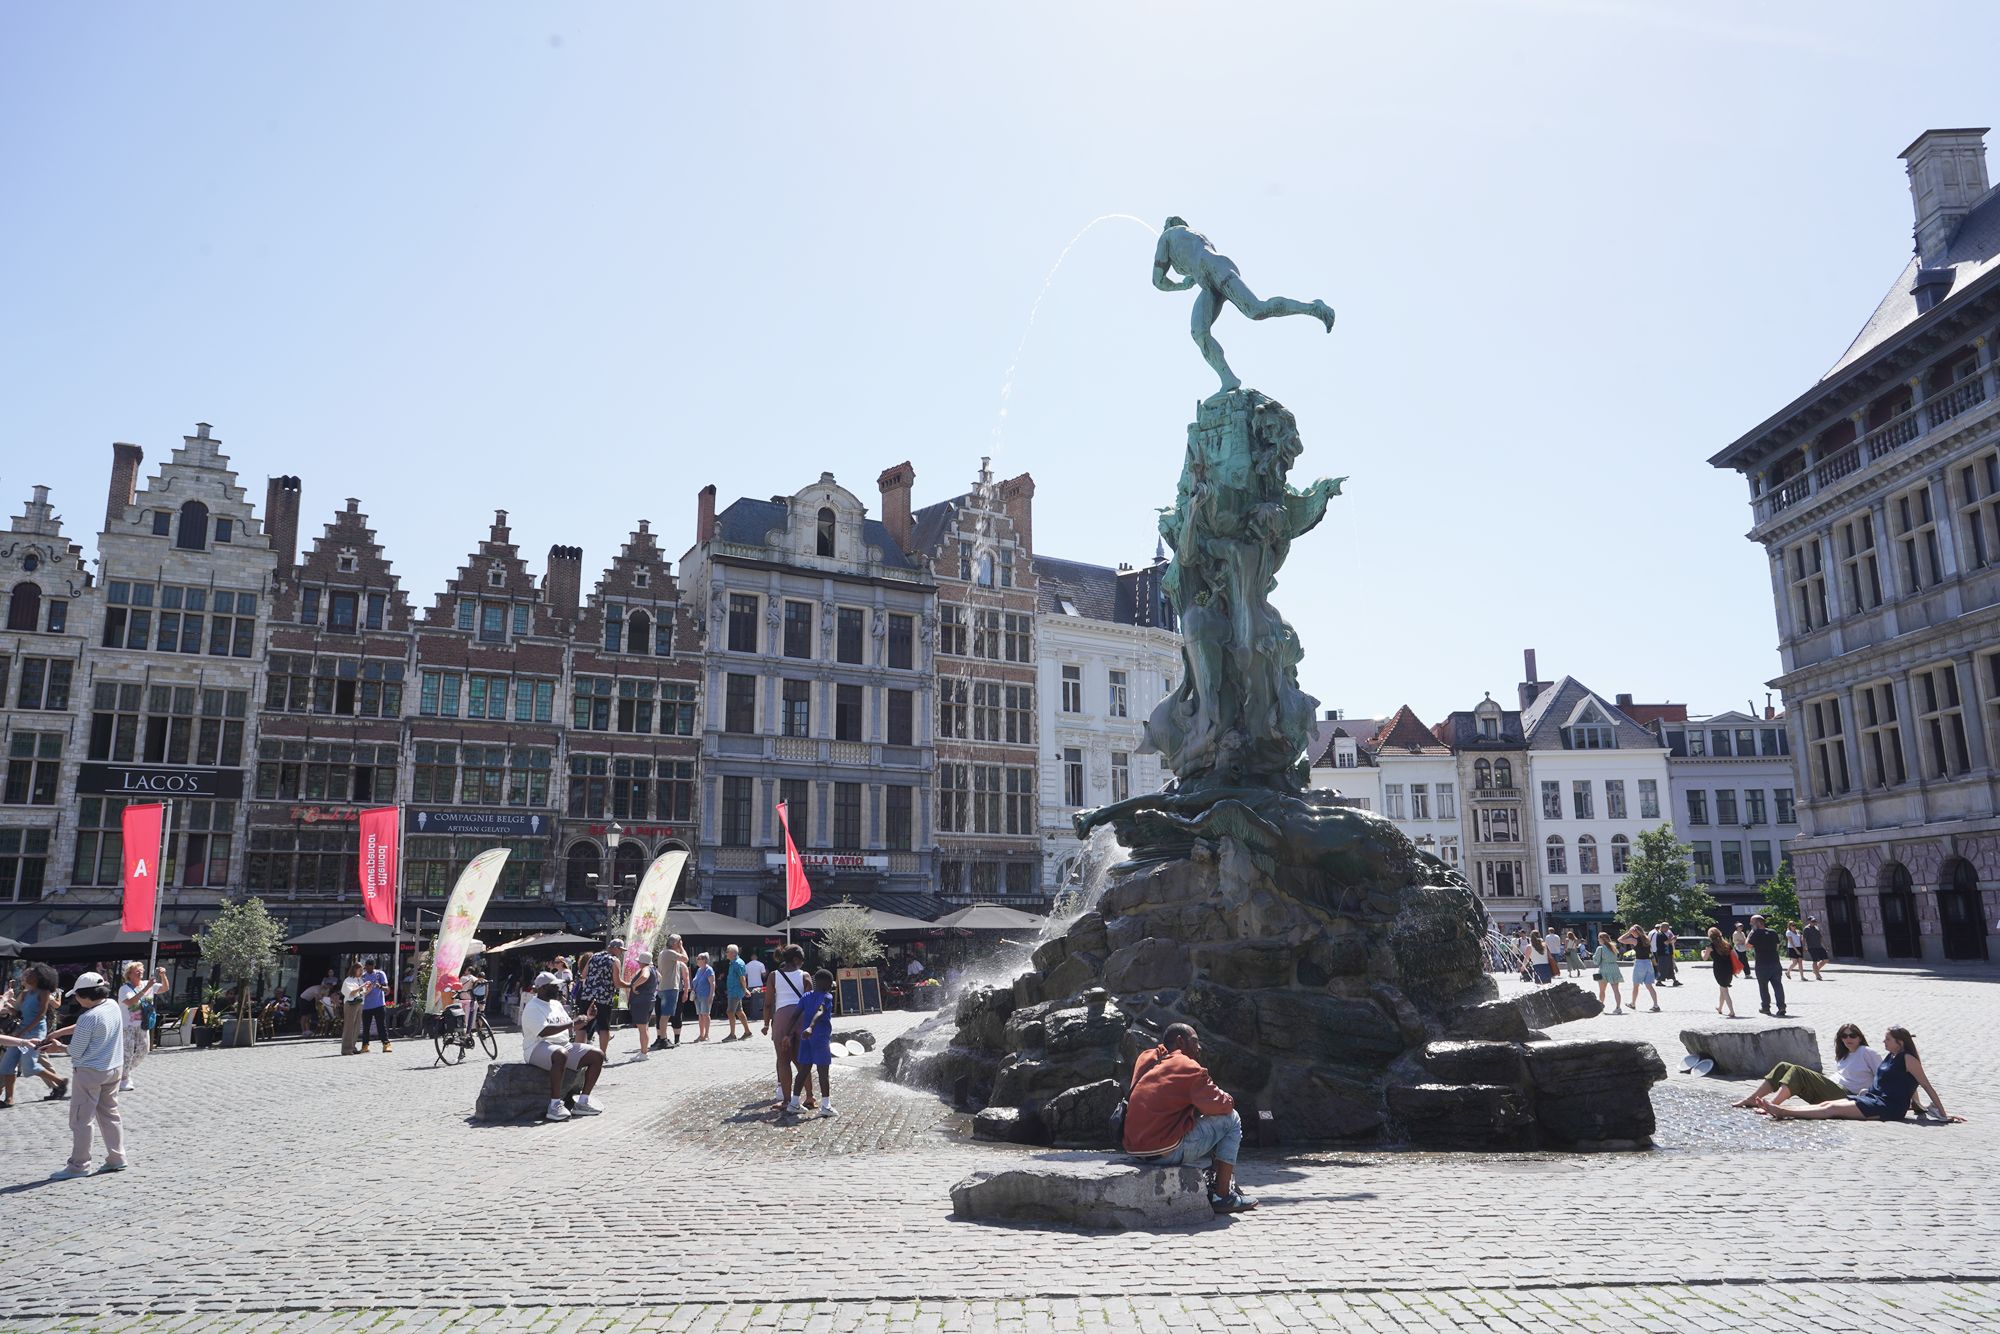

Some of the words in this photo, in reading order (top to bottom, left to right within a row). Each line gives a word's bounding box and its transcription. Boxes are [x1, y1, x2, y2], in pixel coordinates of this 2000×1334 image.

[123, 772, 198, 791] LACO'S
[434, 813, 494, 823] COMPAGNIE
[497, 815, 525, 824] BELGE
[447, 825, 479, 833] ARTISAN
[799, 856, 829, 865] ELLA
[832, 856, 864, 865] PATIO
[133, 858, 148, 878] A
